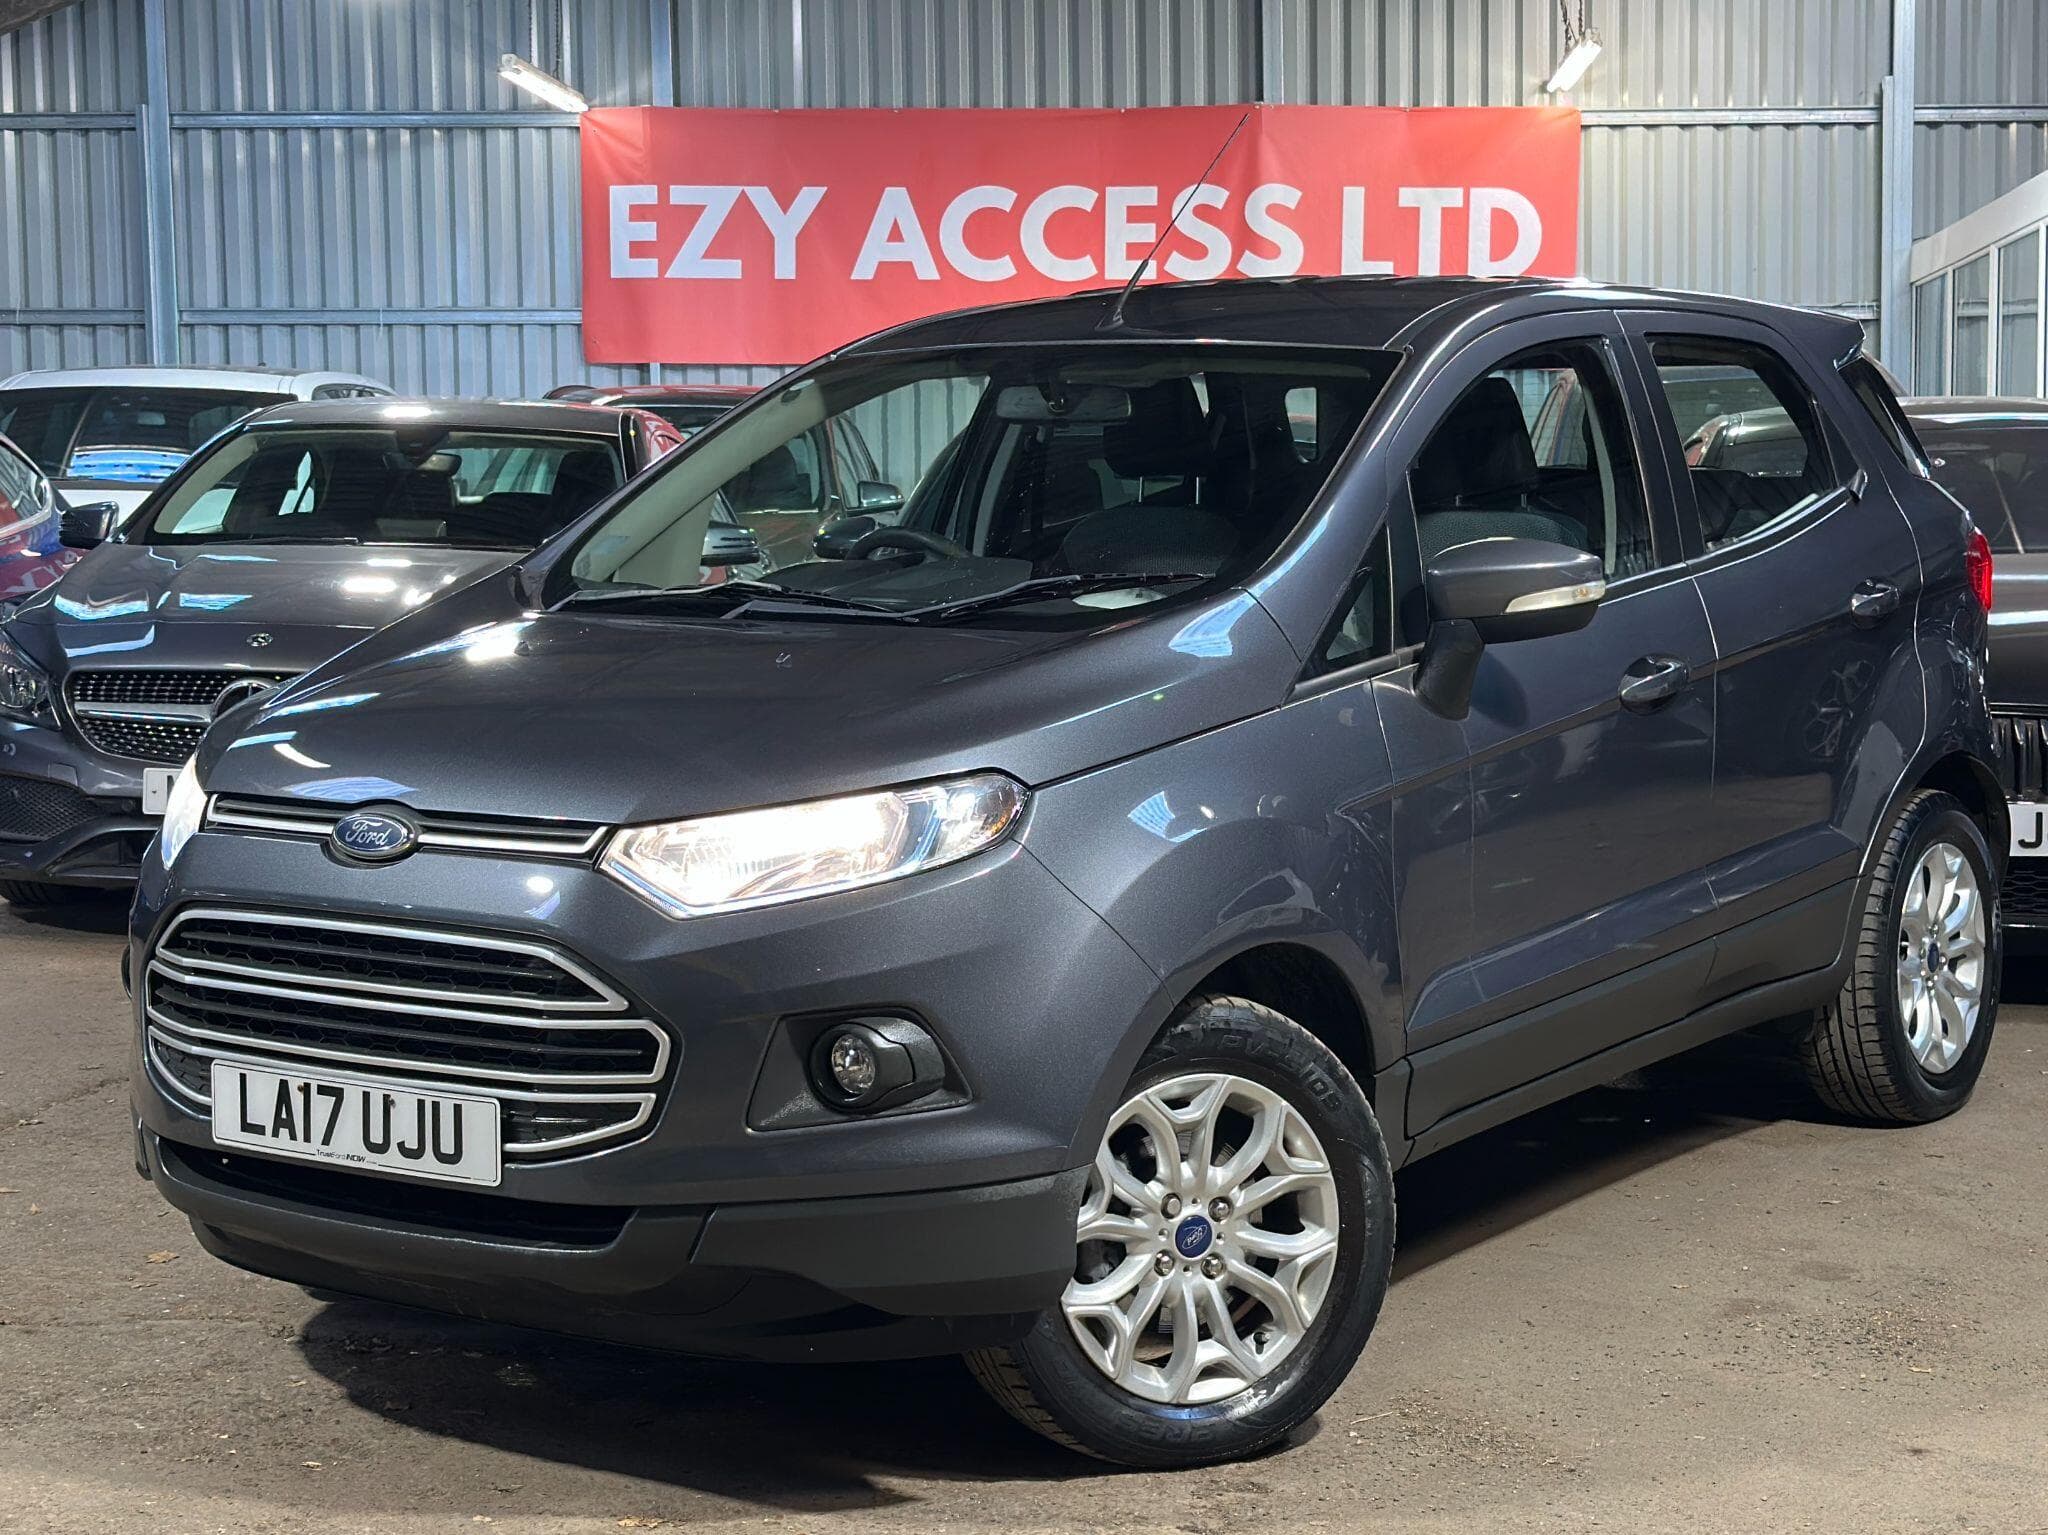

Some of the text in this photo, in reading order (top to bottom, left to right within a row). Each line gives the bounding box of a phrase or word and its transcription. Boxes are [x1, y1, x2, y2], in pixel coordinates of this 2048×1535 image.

[609, 183, 1544, 282] EZY ACCESS LTD
[345, 819, 392, 846] Ford
[2018, 811, 2048, 849] J
[238, 1072, 464, 1165] LA17 UJU
